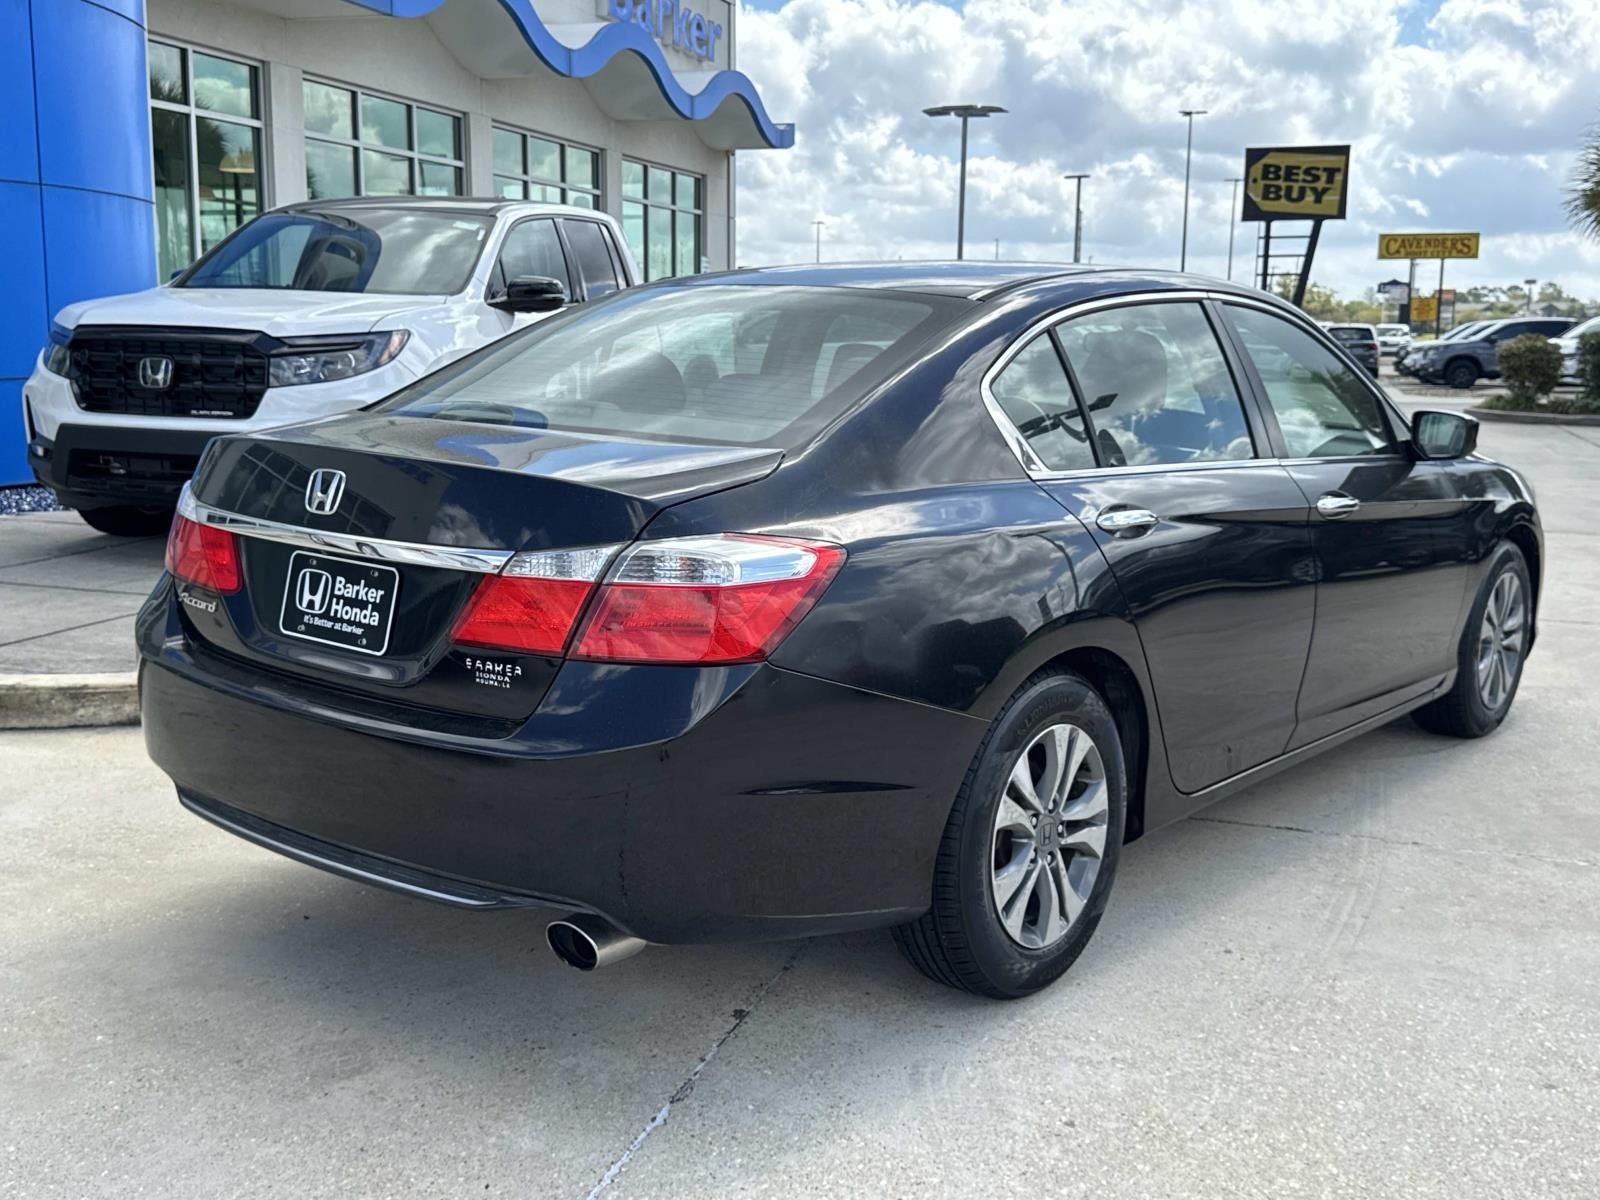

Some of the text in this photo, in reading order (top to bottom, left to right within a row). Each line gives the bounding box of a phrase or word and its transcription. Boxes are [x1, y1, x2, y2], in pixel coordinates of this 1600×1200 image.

[1261, 164, 1341, 185] BEST
[1261, 185, 1331, 204] BUY
[334, 576, 384, 603] Barker
[178, 592, 216, 613] Accord
[330, 597, 380, 626] Honda
[303, 614, 365, 635] It's Better at Barker
[475, 671, 511, 682] HONDA
